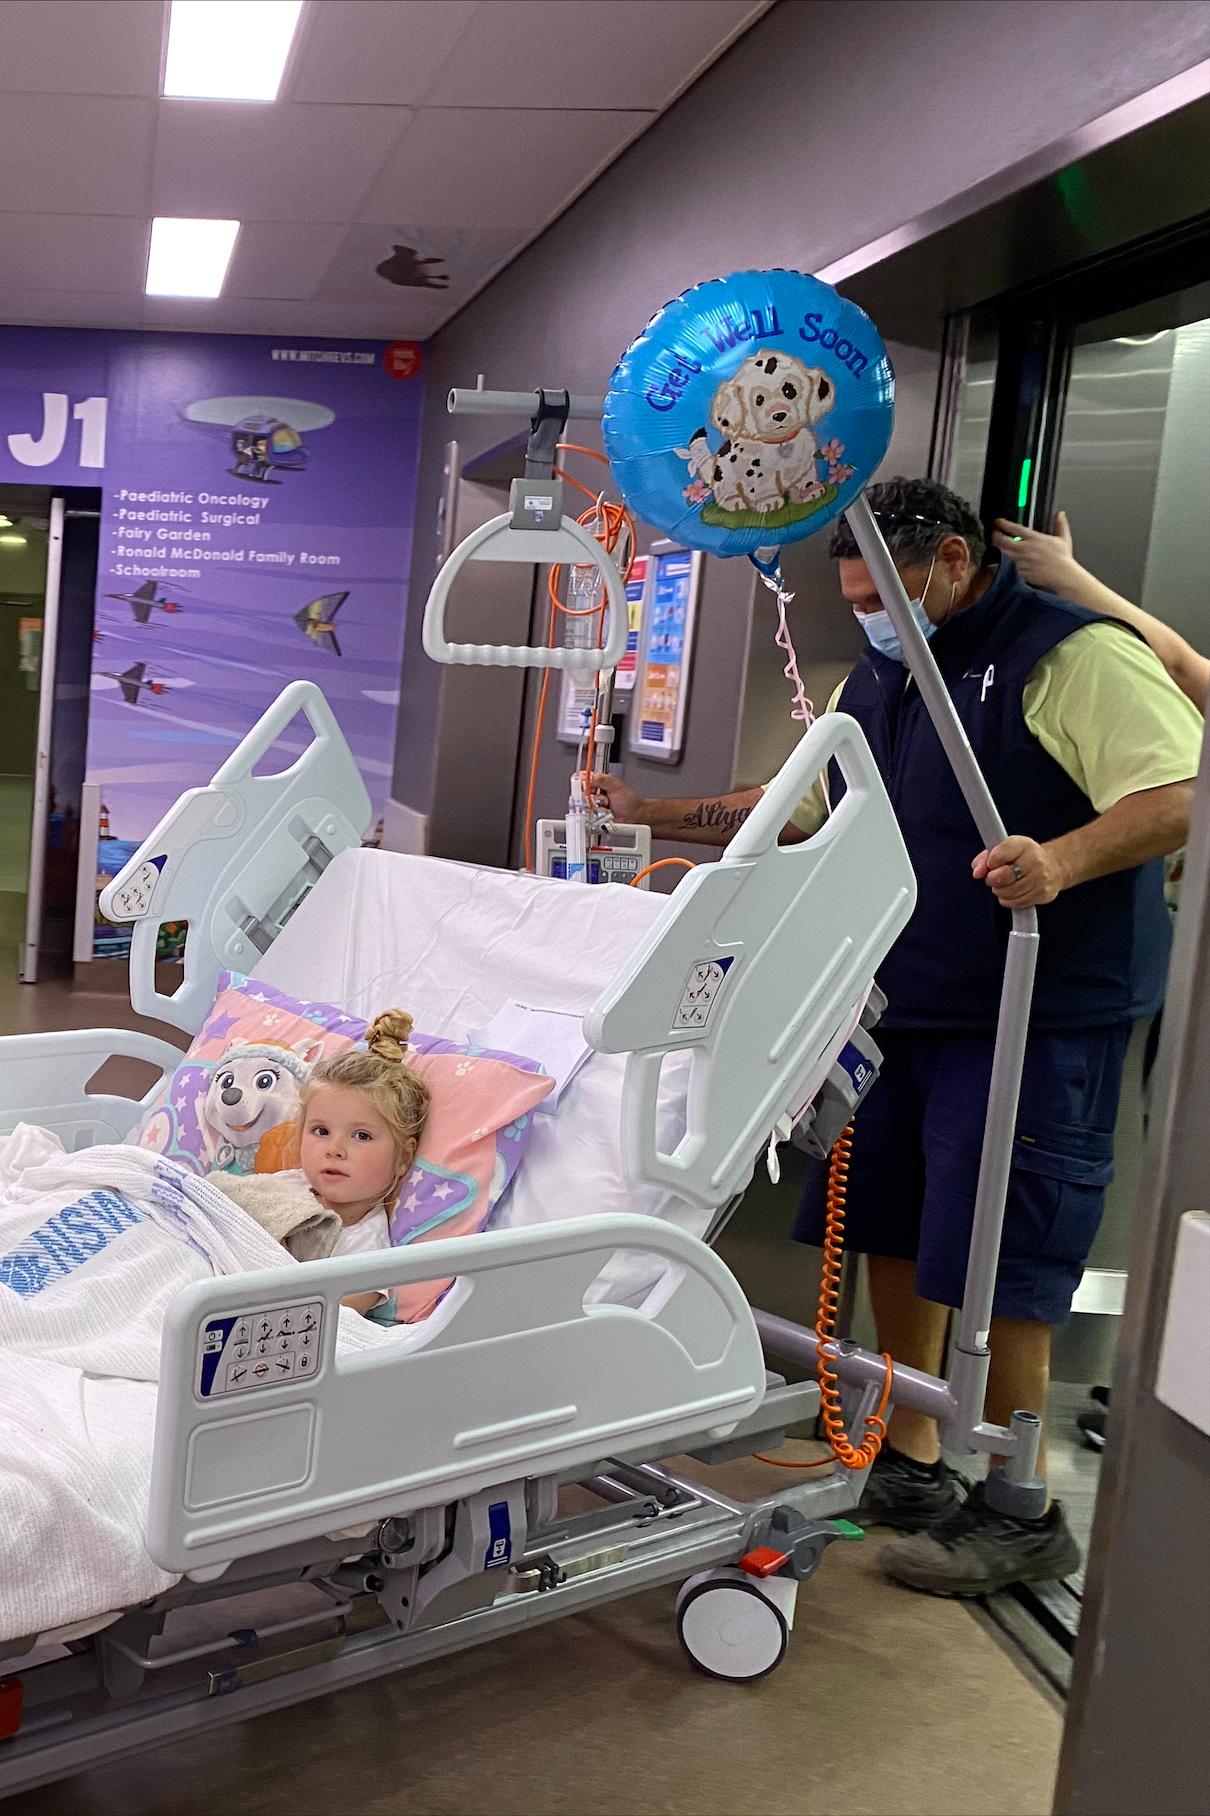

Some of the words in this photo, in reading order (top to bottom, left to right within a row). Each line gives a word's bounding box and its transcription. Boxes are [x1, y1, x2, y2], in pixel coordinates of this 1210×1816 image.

[645, 354, 702, 412] Get
[700, 306, 784, 352] Well
[799, 312, 868, 379] Soon
[8, 393, 108, 468] J1
[198, 493, 269, 509] Oncology
[201, 511, 261, 526] Surgical
[156, 528, 211, 541] Garden
[170, 547, 244, 561] McDonald
[248, 550, 295, 566] Family
[299, 552, 341, 565] Room
[31, 1190, 144, 1276] NSW
